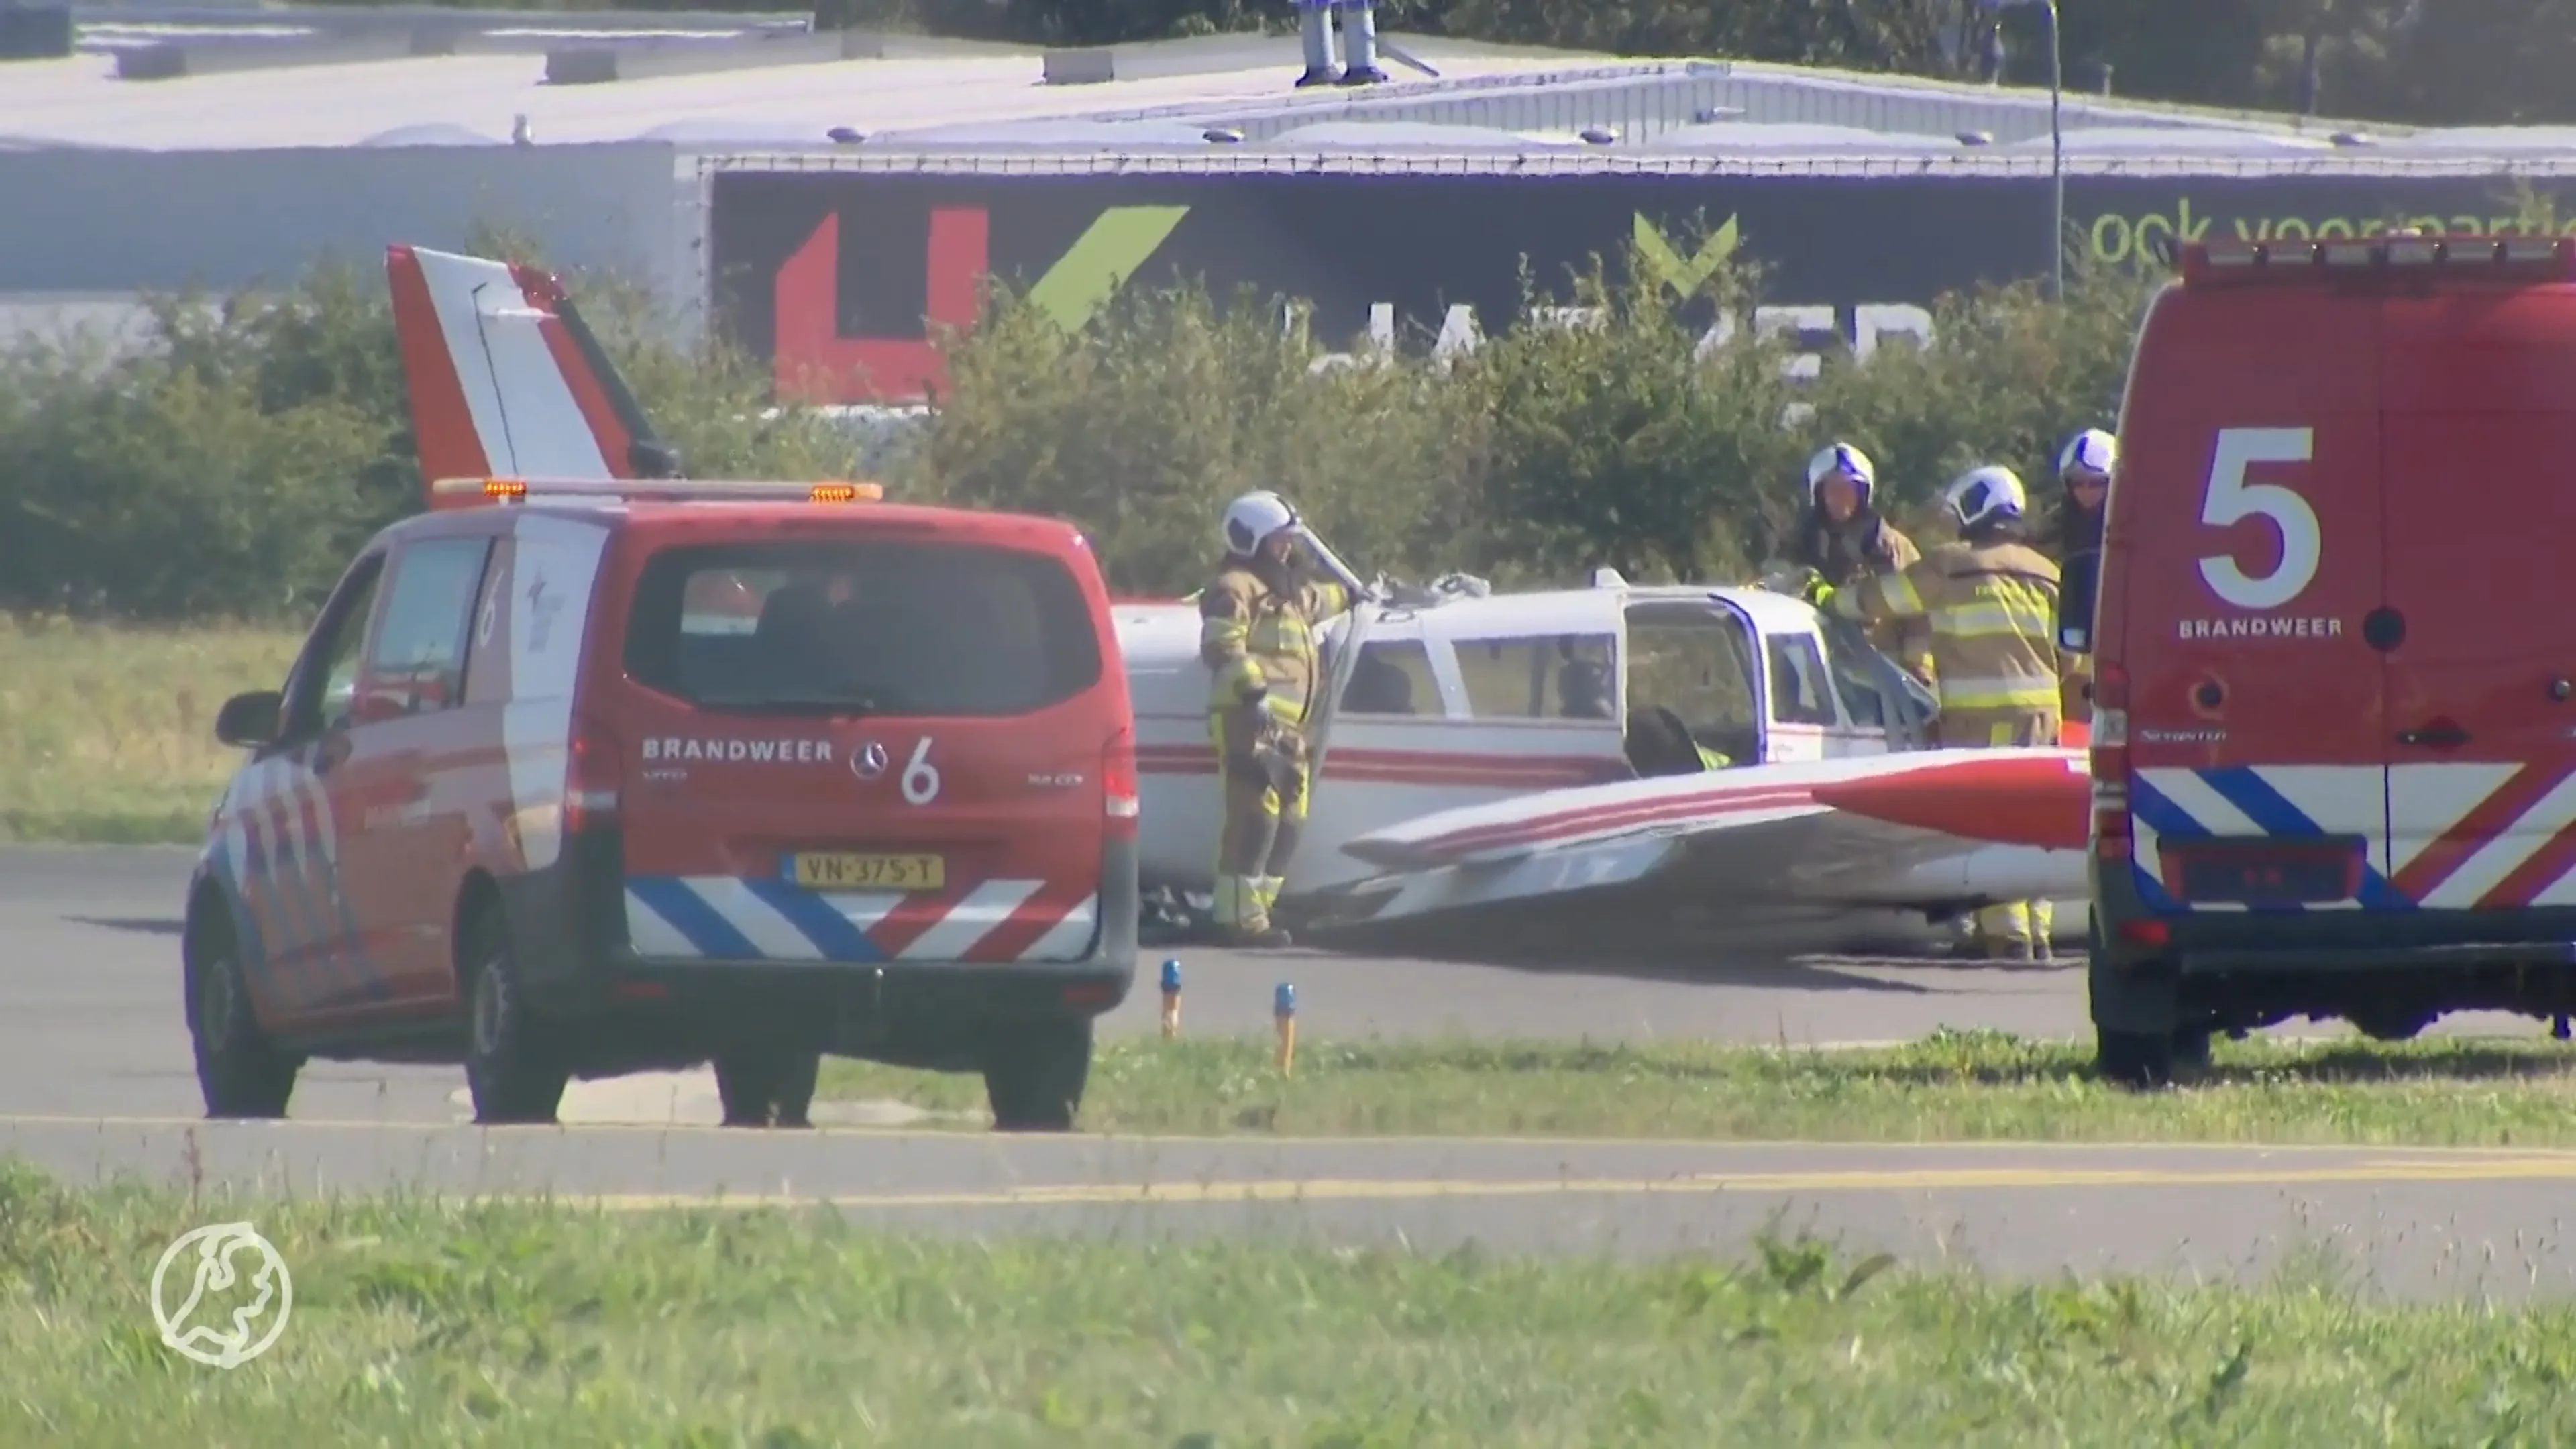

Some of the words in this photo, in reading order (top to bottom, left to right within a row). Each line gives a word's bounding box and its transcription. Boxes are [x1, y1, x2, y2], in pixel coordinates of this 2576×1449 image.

[2092, 197, 2212, 264] ook
[2198, 427, 2321, 608] 5
[2179, 618, 2341, 639] BRANDWEER
[642, 738, 832, 763] BRANDWEER
[901, 736, 940, 806] 6
[807, 857, 932, 882] VN-375-T
